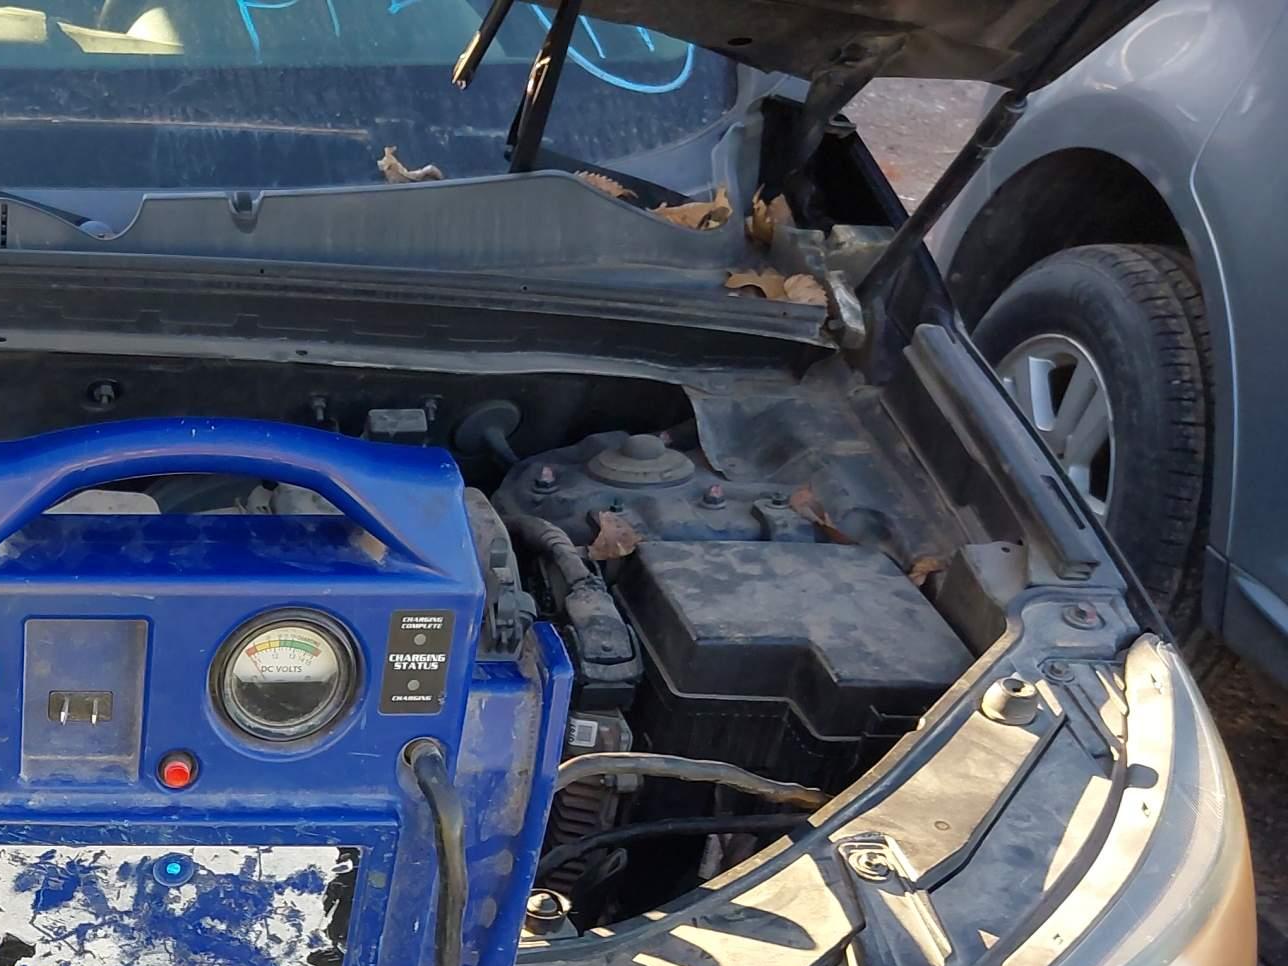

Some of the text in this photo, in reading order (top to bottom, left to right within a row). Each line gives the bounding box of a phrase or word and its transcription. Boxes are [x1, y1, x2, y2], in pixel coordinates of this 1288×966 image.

[388, 653, 447, 662] CHARGING
[261, 665, 303, 673] DC VOLTS
[393, 662, 439, 670] STATUS
